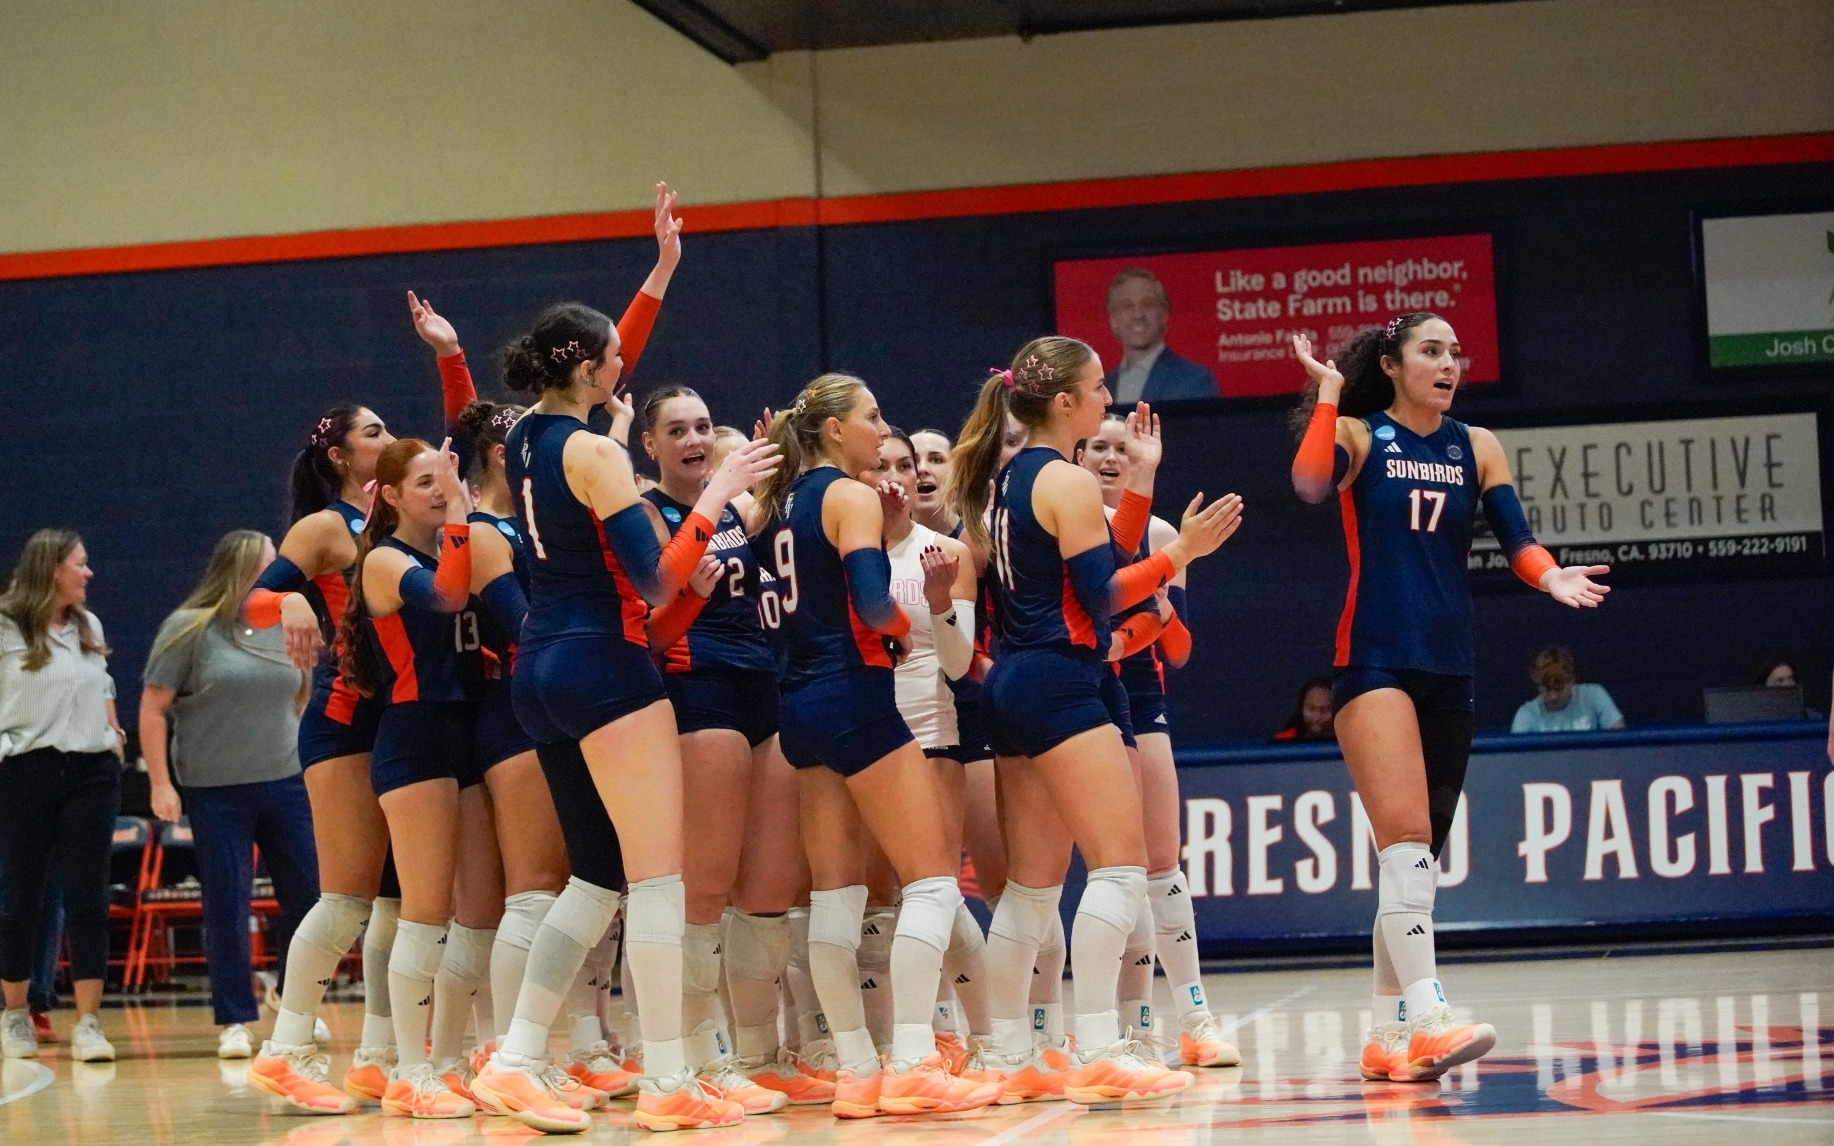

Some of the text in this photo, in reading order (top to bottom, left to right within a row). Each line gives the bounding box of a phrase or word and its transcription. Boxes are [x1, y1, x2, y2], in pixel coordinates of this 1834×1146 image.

[1215, 258, 1468, 294] Like a good neighbor,
[1216, 298, 1281, 321] State
[1287, 293, 1352, 317] Farm
[1358, 290, 1378, 313] is
[1765, 336, 1817, 357] Josh
[1386, 458, 1464, 486] SUNBIRDS
[1514, 433, 1784, 501] EXECUTIVE
[1408, 488, 1448, 532] 17
[1528, 493, 1777, 533] AUTO CENTER
[994, 506, 1016, 591] 11
[1618, 544, 1645, 562] CA.
[1648, 541, 1693, 560] 93710
[1708, 535, 1807, 557] 559-222-9191
[774, 527, 798, 615] 9
[454, 610, 480, 653] 13
[1517, 771, 1834, 883] PACIFI
